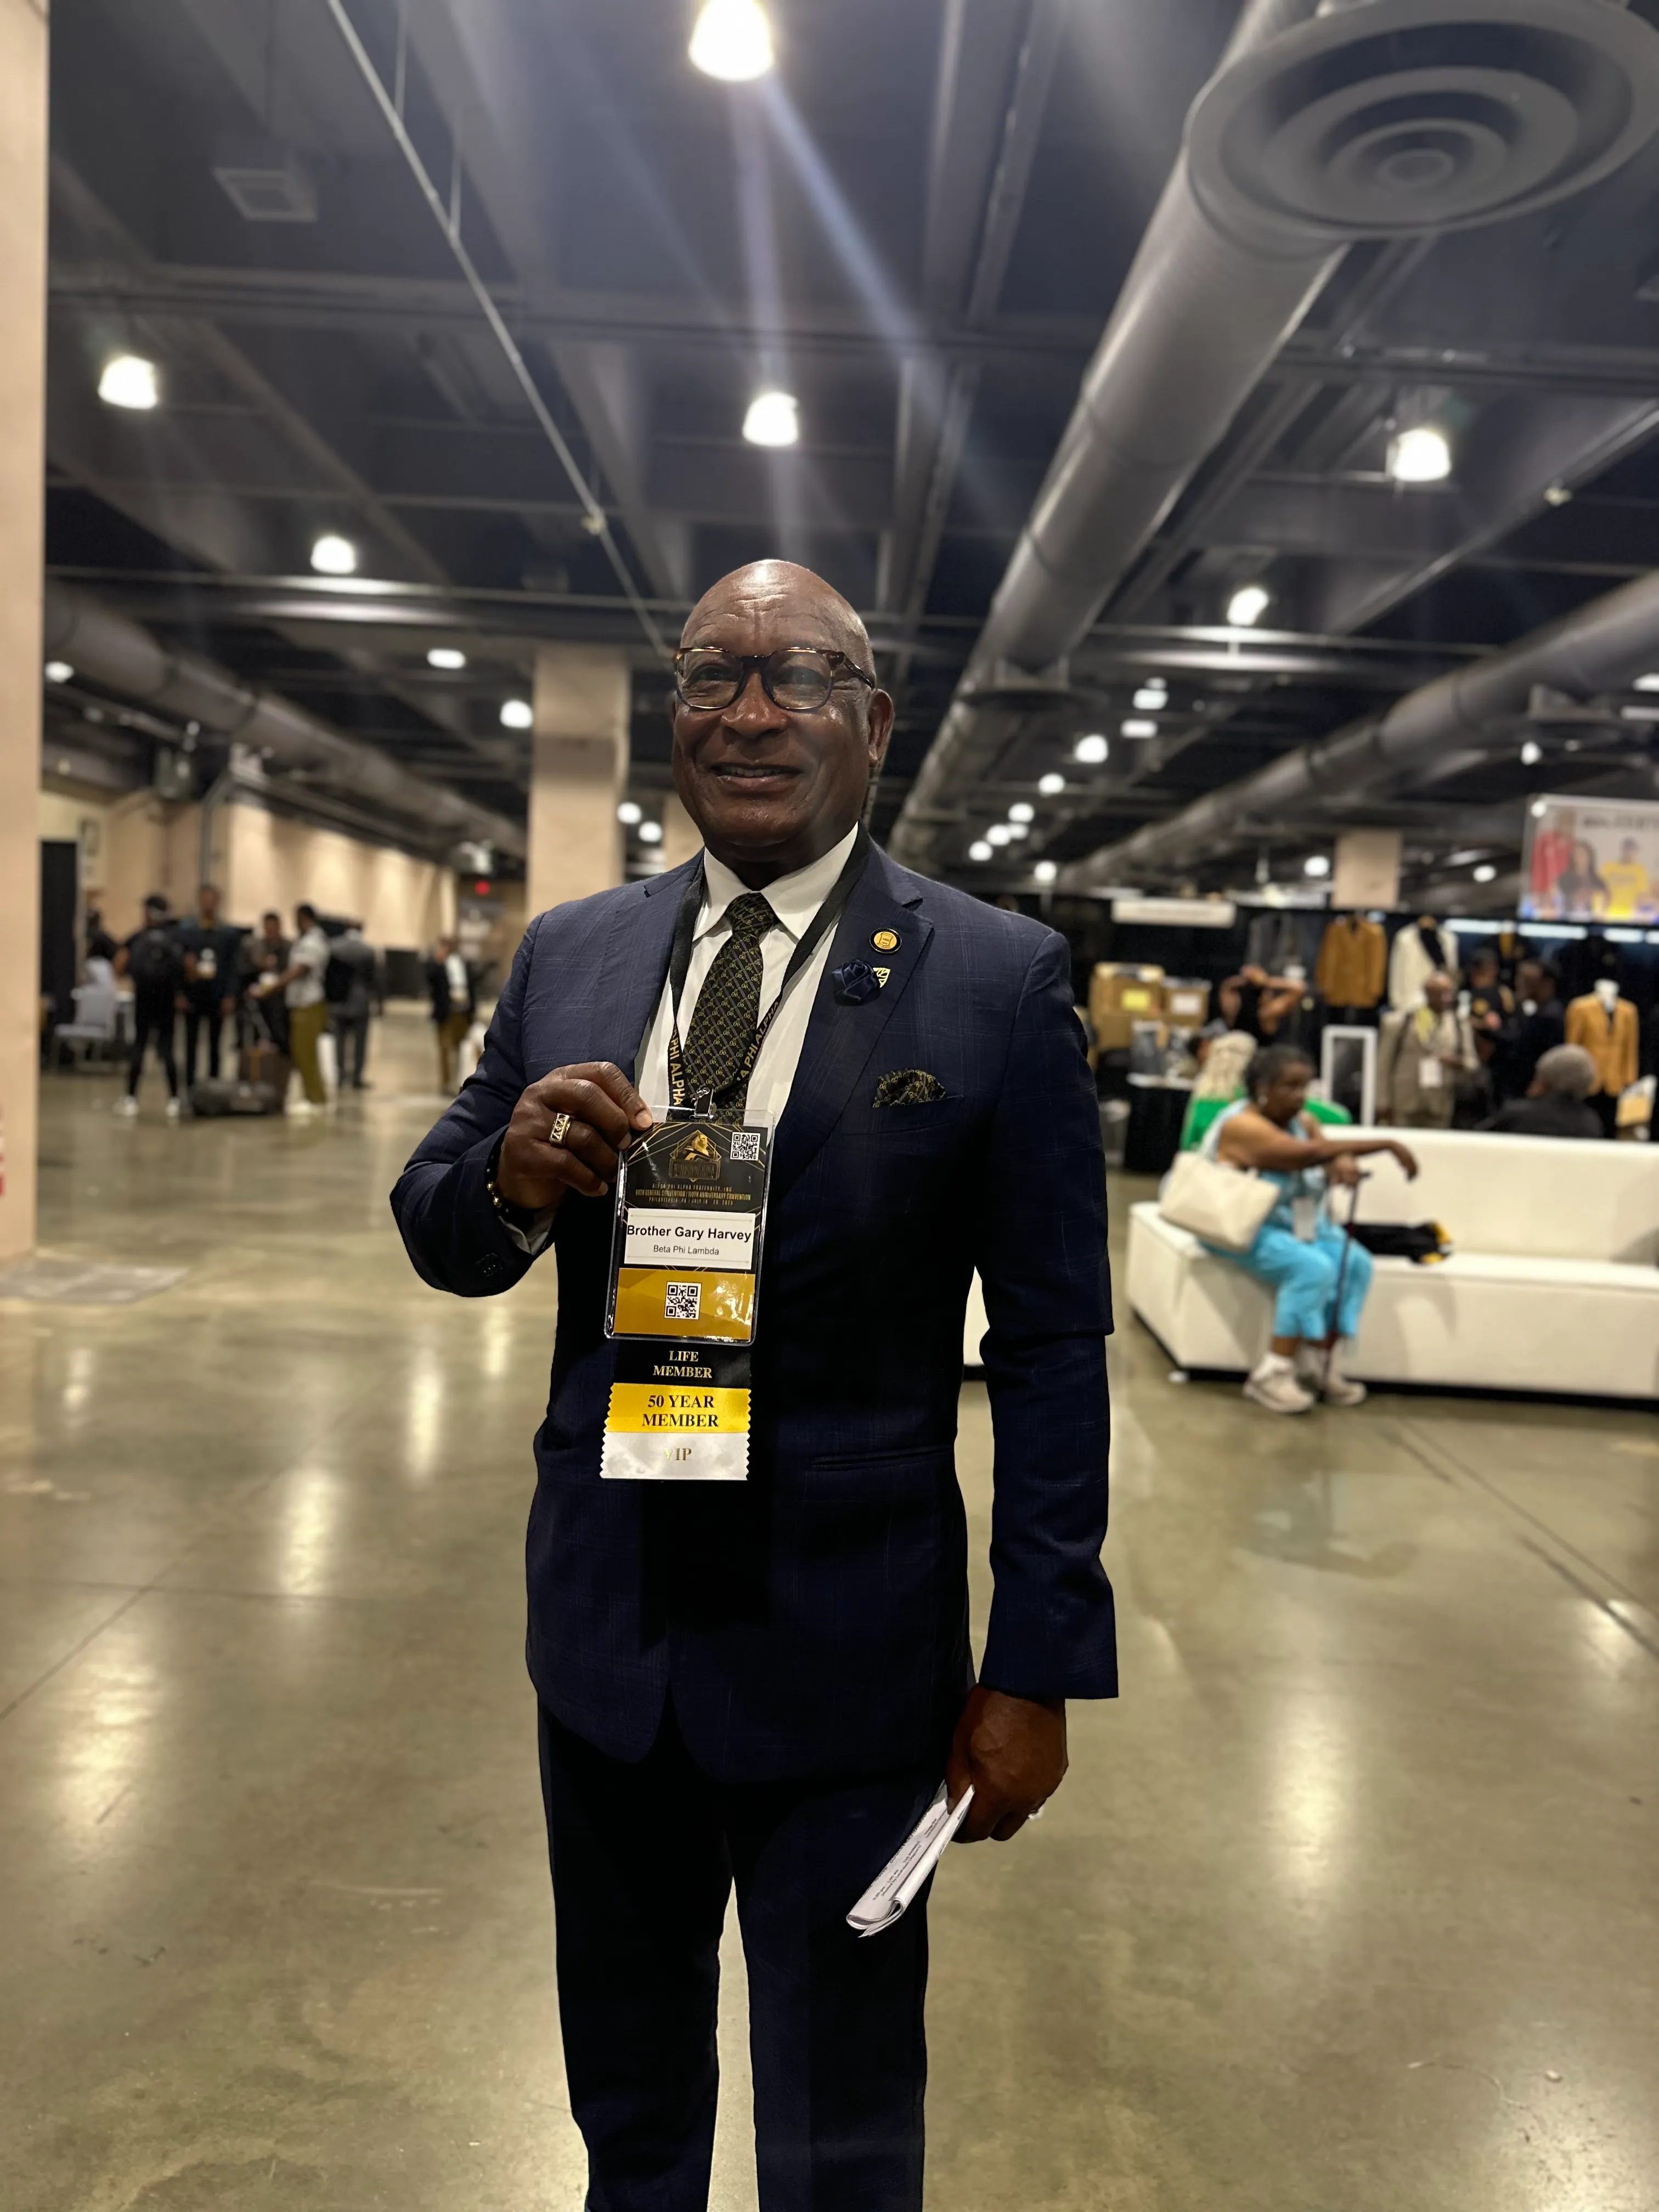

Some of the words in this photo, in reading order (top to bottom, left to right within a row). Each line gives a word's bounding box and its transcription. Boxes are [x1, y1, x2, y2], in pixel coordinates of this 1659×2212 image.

[670, 1037, 679, 1059] PHI
[744, 1043, 758, 1068] PHI
[670, 1063, 685, 1105] ALPHA
[627, 1225, 671, 1236] Brother
[675, 1227, 704, 1240] Gary
[708, 1228, 751, 1243] Harvey
[653, 1245, 670, 1253] Beta
[673, 1245, 685, 1254] Phi
[688, 1246, 719, 1255] Lambda
[669, 1350, 699, 1362] LIFE
[653, 1365, 712, 1378] MEMBER
[647, 1395, 664, 1408] 50
[668, 1395, 714, 1408] YEAR
[641, 1414, 719, 1427] MEMBER
[664, 1447, 692, 1460] VIP
